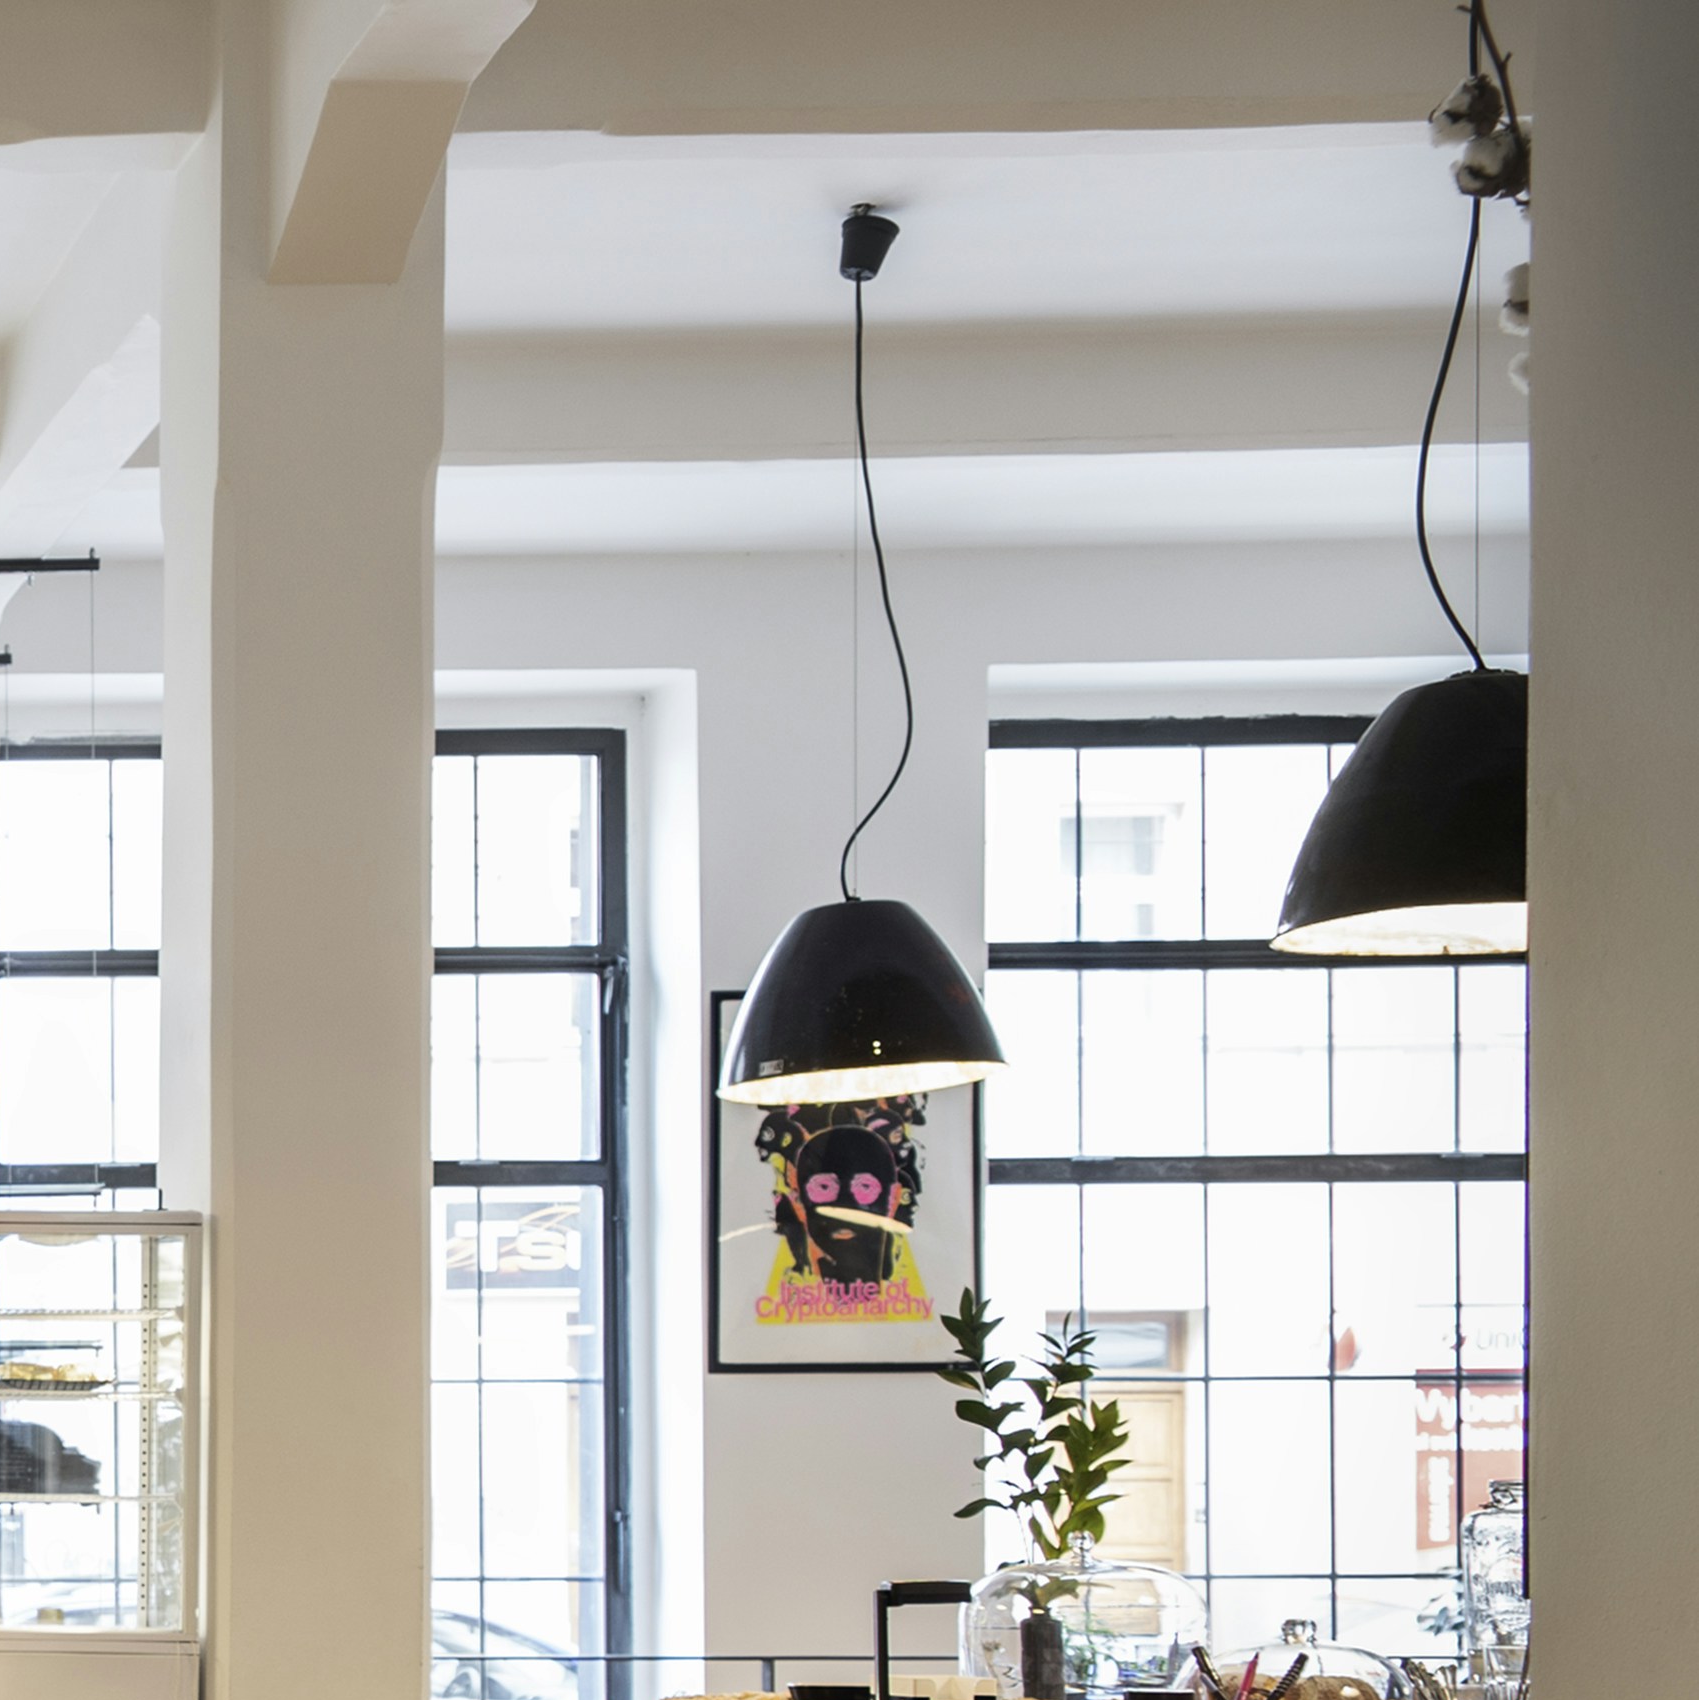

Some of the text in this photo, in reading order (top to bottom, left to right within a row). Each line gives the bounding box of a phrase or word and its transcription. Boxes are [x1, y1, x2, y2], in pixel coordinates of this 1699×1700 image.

[780, 1277, 909, 1306] Institute of
[755, 1293, 934, 1322] Cryptoanarchy
